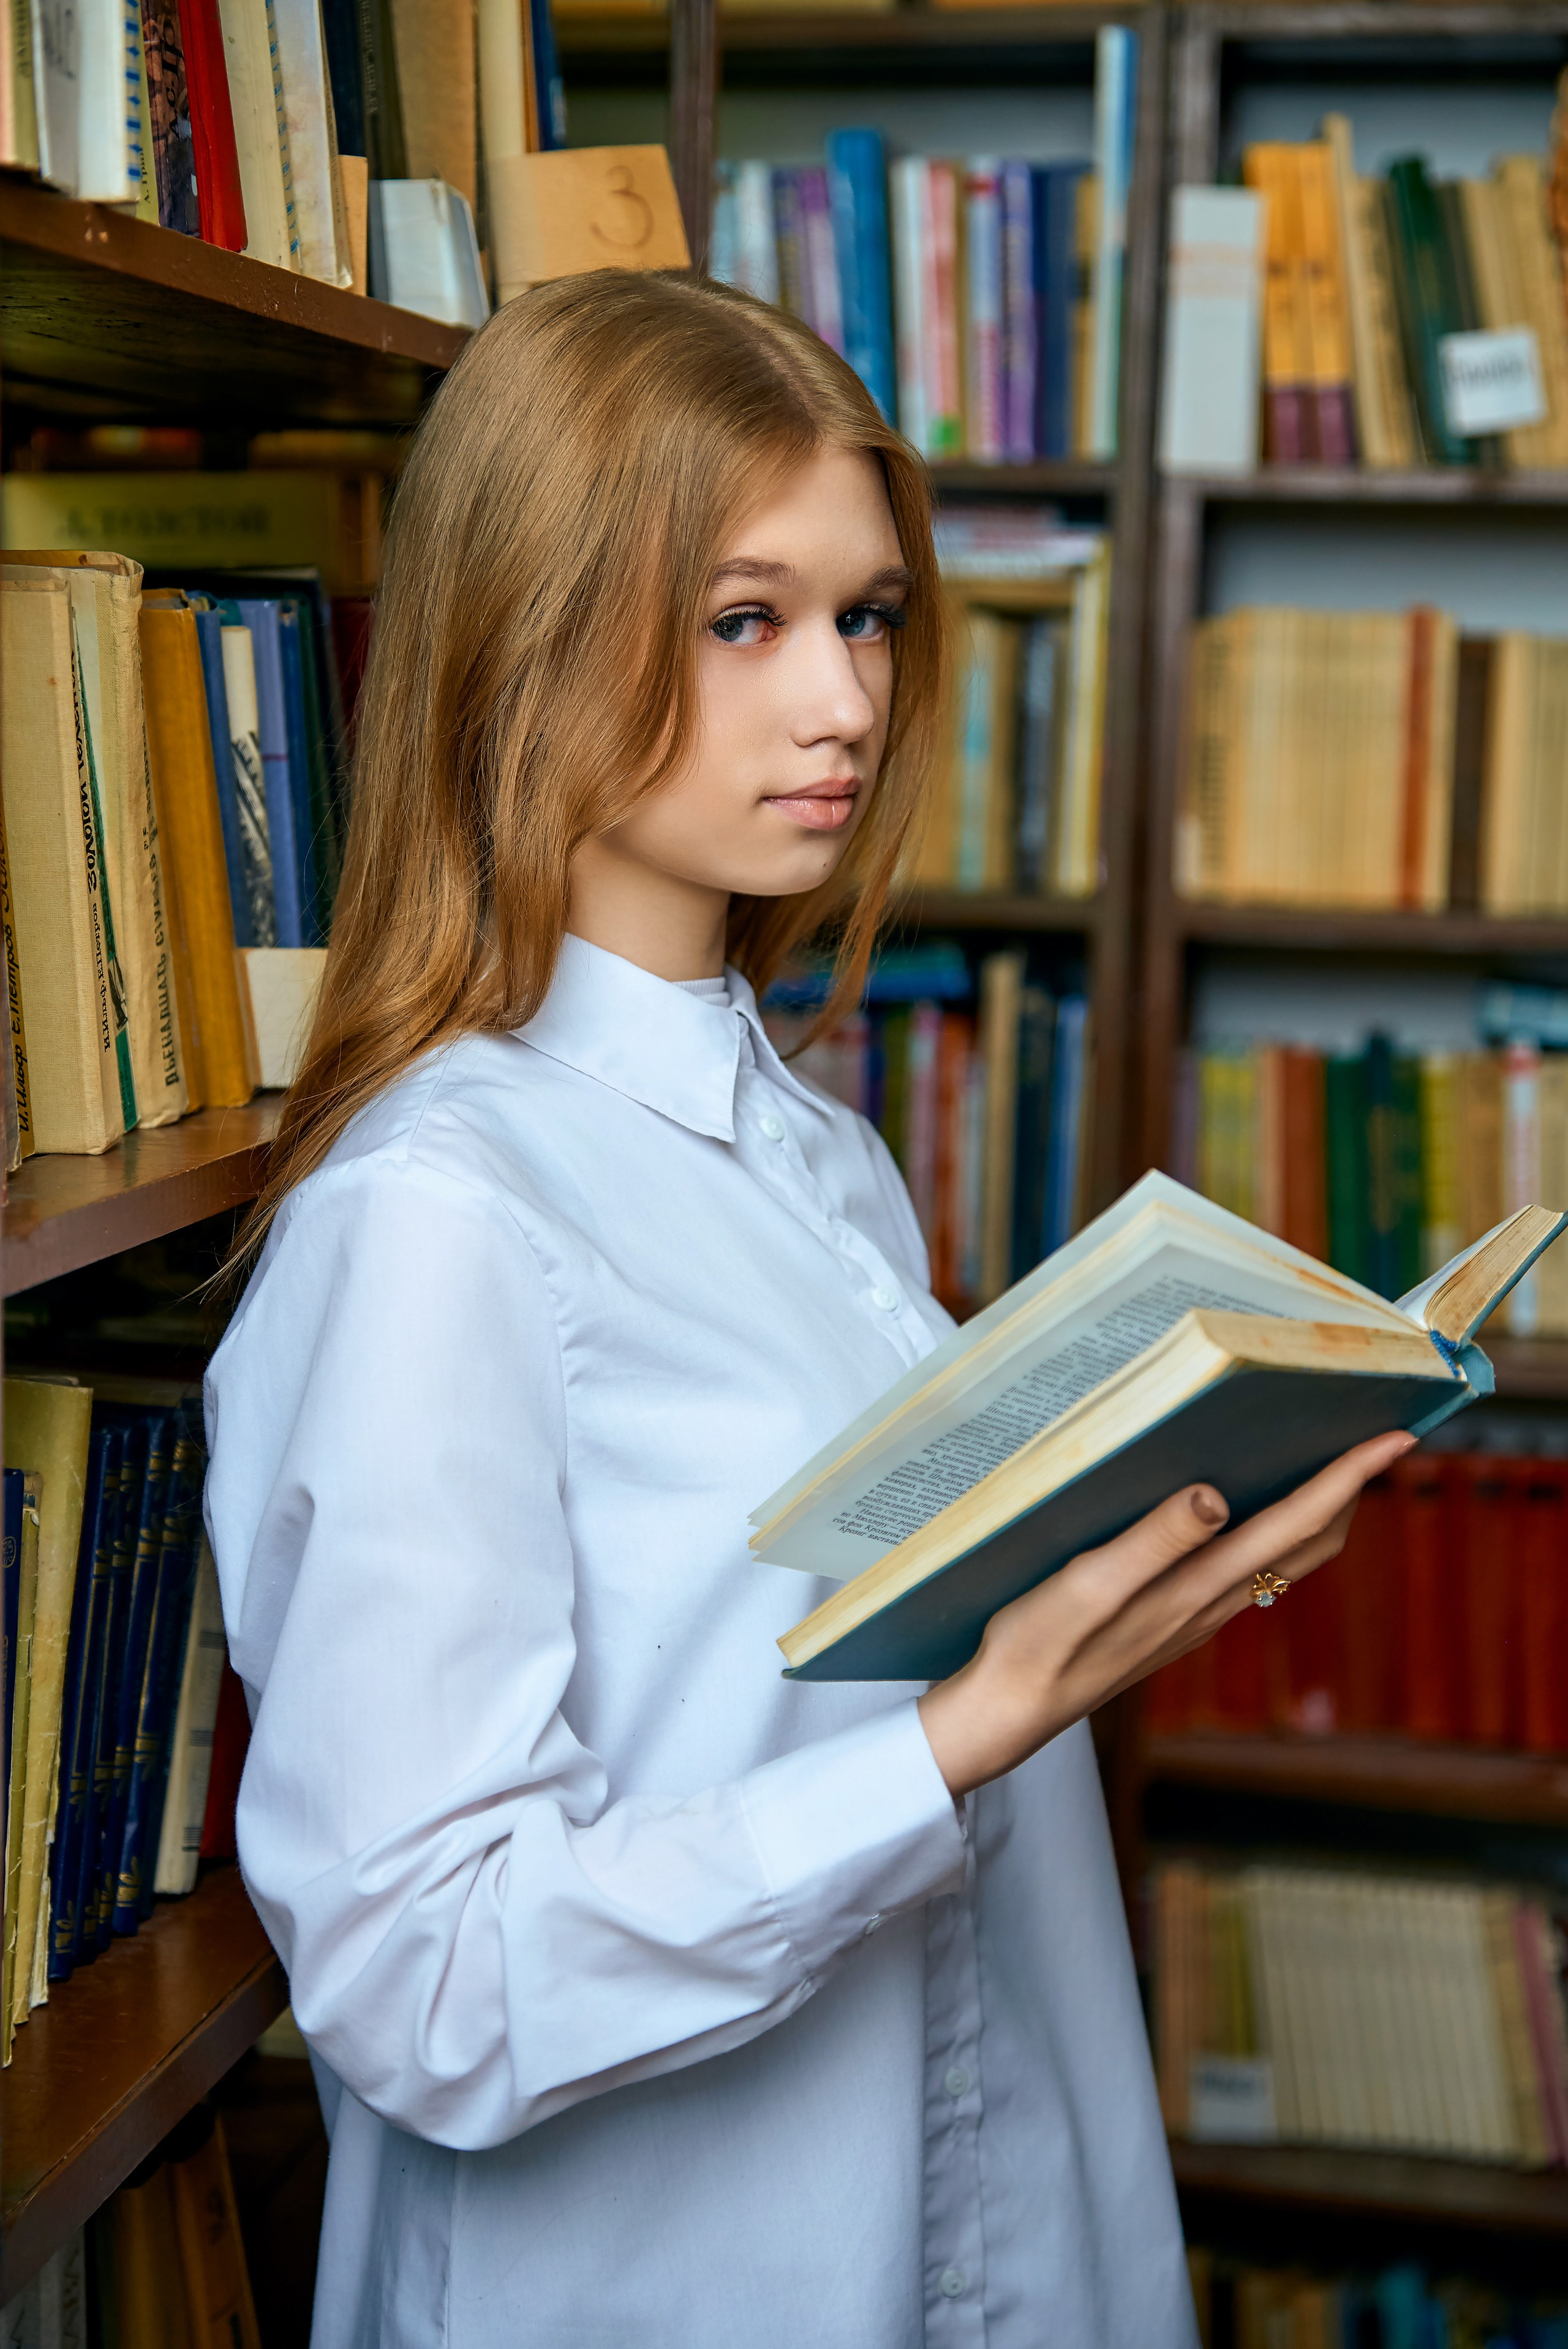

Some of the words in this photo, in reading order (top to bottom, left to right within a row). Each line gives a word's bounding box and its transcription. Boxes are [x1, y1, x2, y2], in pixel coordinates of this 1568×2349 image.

[589, 165, 655, 247] 3
[927, 1457, 959, 1471] Мюллер
[960, 1468, 979, 1477] знал,
[940, 1454, 979, 1468] хранилищ
[884, 1477, 916, 1490] камерах,
[891, 1471, 946, 1488] финансистах,
[928, 1473, 964, 1487] Шторхом
[875, 1491, 897, 1501] сутки,
[876, 1484, 914, 1496] вершенно
[859, 1495, 920, 1514] возбуждающих
[852, 1514, 894, 1528] Мюллеру
[856, 1509, 897, 1522] Накануне
[884, 1509, 925, 1523] старческие
[839, 1525, 870, 1536] Крозиг
[864, 1525, 904, 1538] Крозигом
